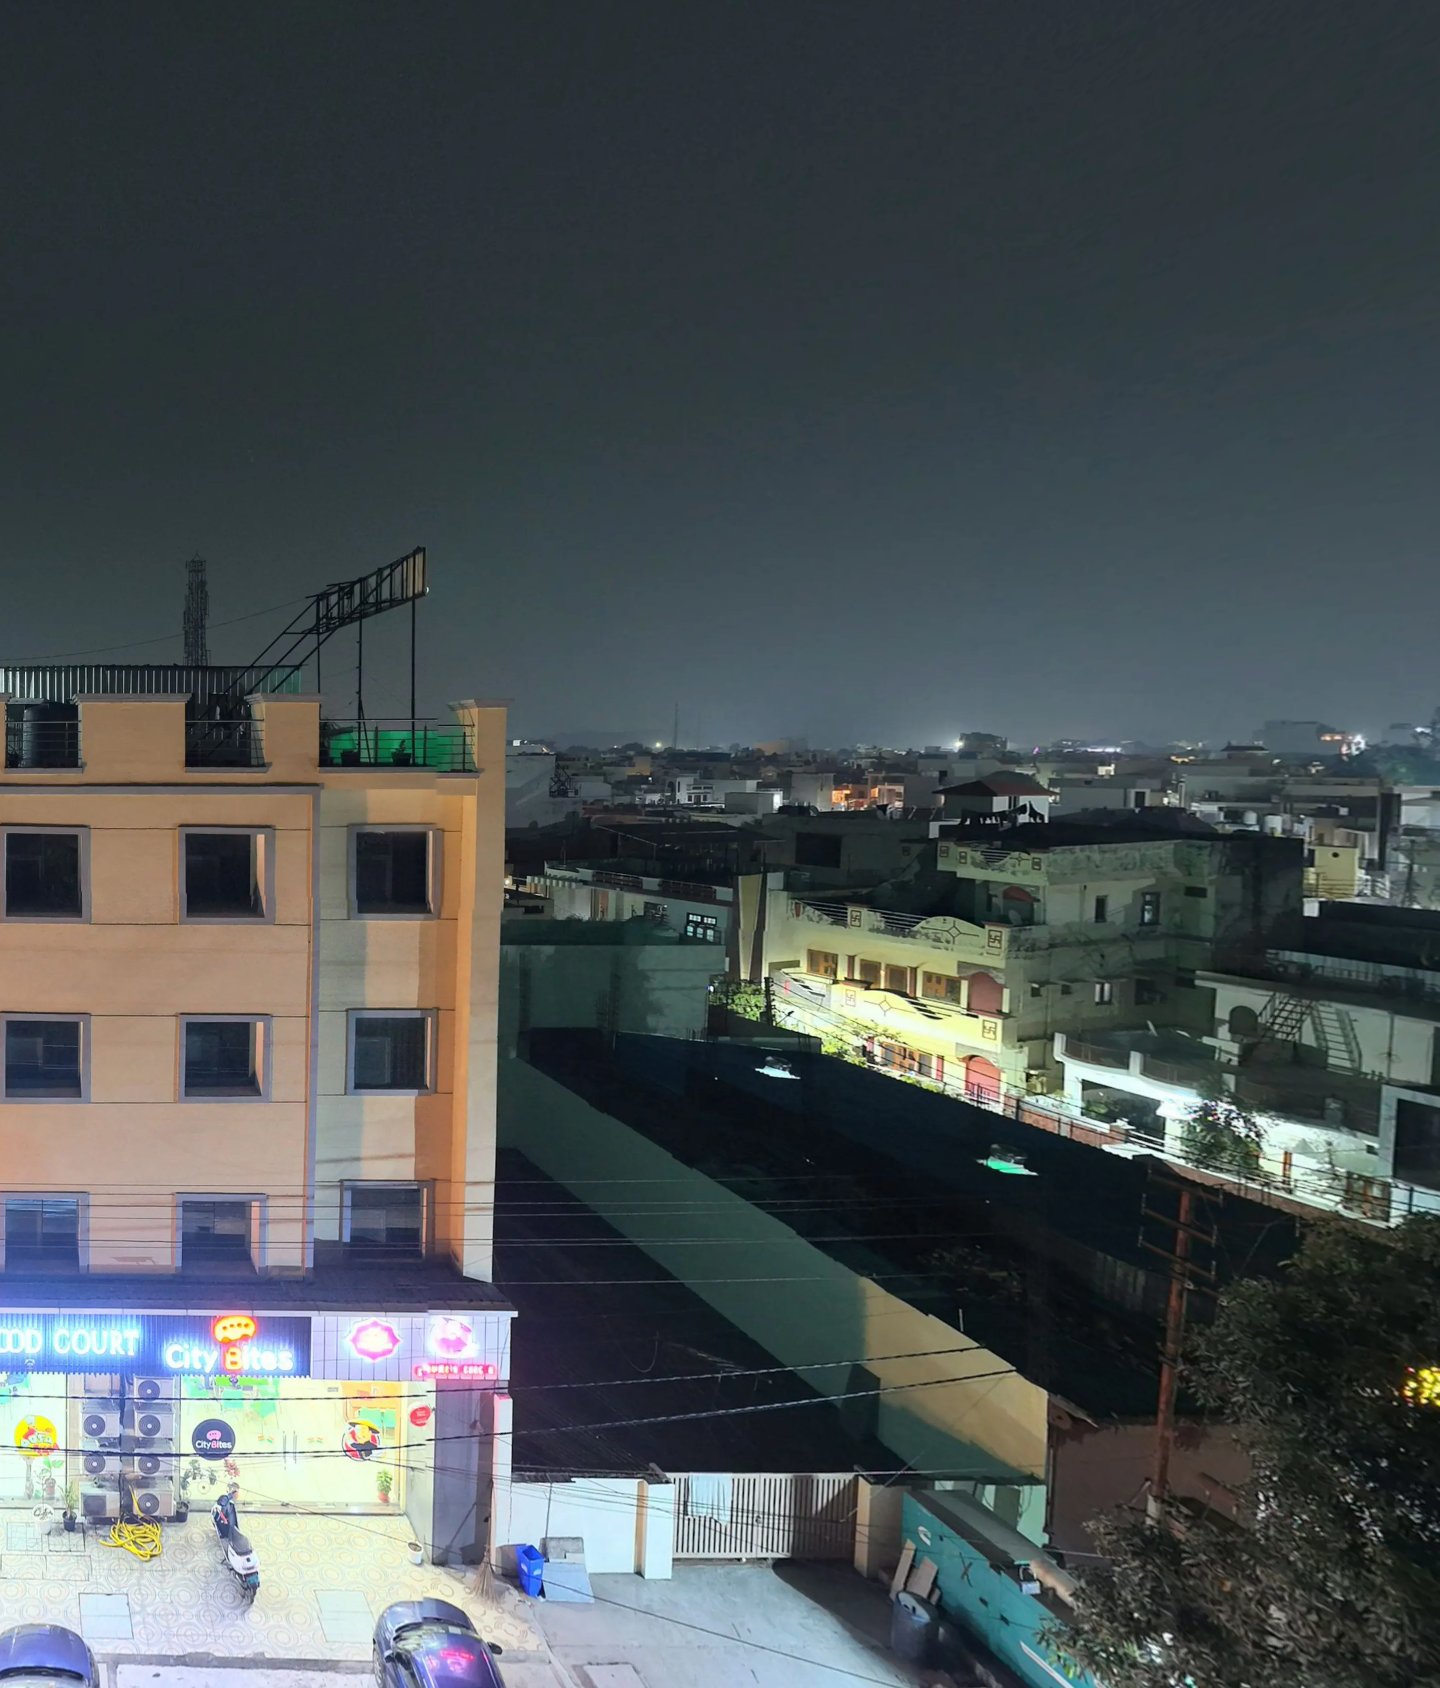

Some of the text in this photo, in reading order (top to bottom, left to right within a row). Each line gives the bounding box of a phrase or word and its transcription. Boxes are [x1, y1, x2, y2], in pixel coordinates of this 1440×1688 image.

[53, 1328, 140, 1356] COURT
[165, 1343, 295, 1374] City Bites
